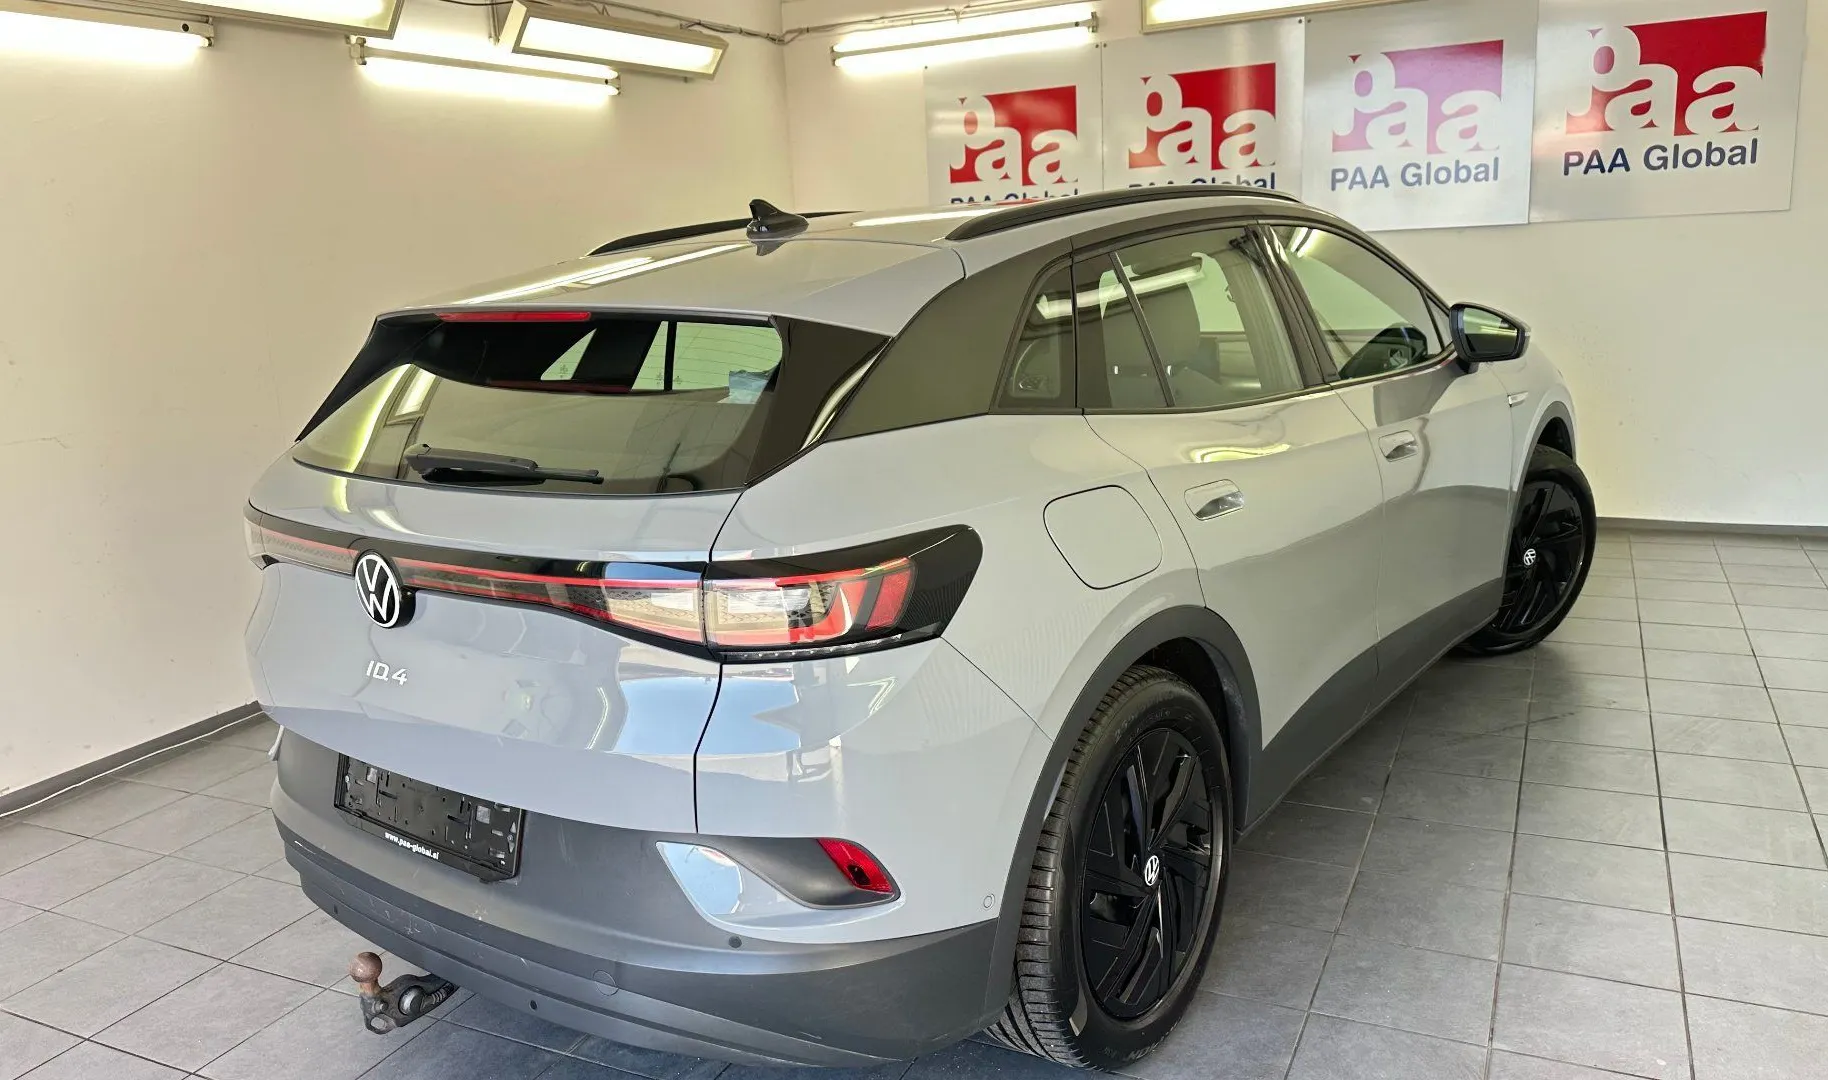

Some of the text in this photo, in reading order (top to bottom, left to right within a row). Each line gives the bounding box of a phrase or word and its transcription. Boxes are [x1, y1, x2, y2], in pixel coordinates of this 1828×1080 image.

[1330, 156, 1499, 192] PAA Global
[1563, 137, 1758, 176] PAA Global
